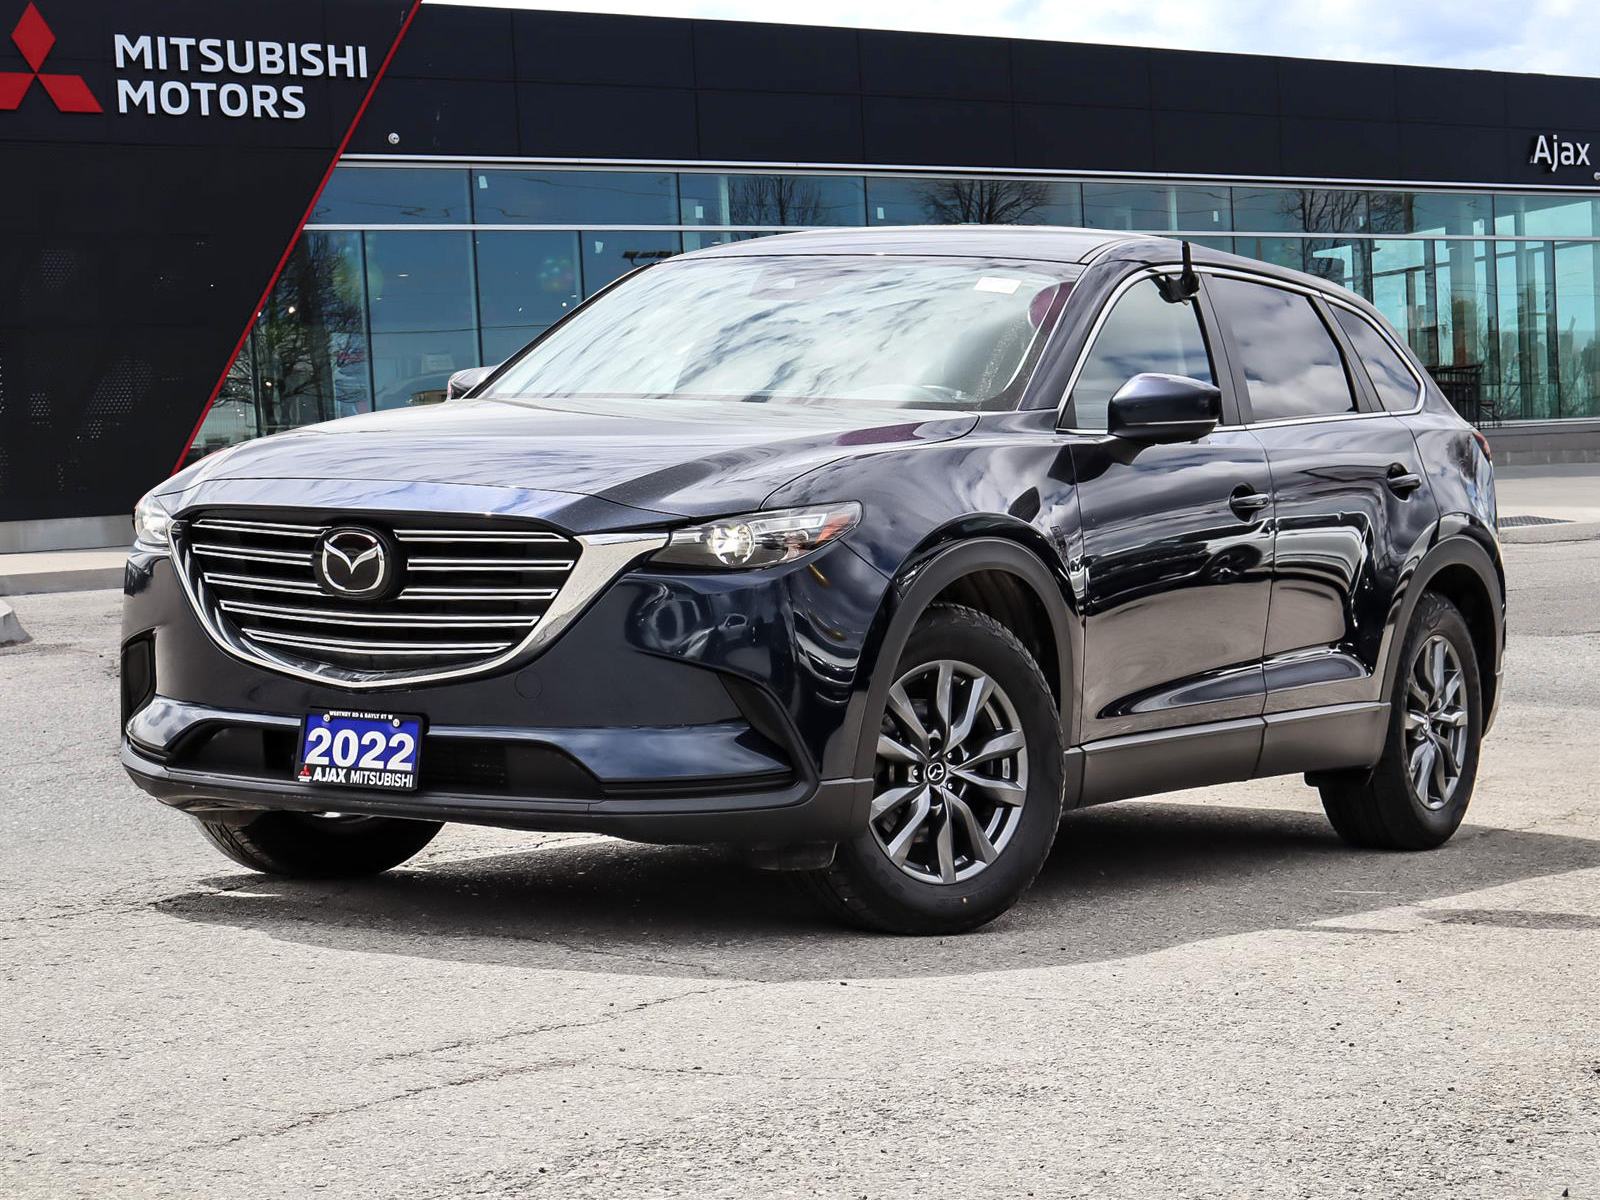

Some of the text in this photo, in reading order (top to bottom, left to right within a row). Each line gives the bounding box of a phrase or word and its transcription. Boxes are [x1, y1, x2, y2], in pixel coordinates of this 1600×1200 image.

[114, 33, 368, 78] MITSUBISHI
[117, 79, 306, 119] MOTORS
[1533, 134, 1590, 172] Ajax
[304, 727, 415, 771] 2022
[312, 767, 347, 783] AJAX
[350, 770, 413, 788] MITSUBISHI
